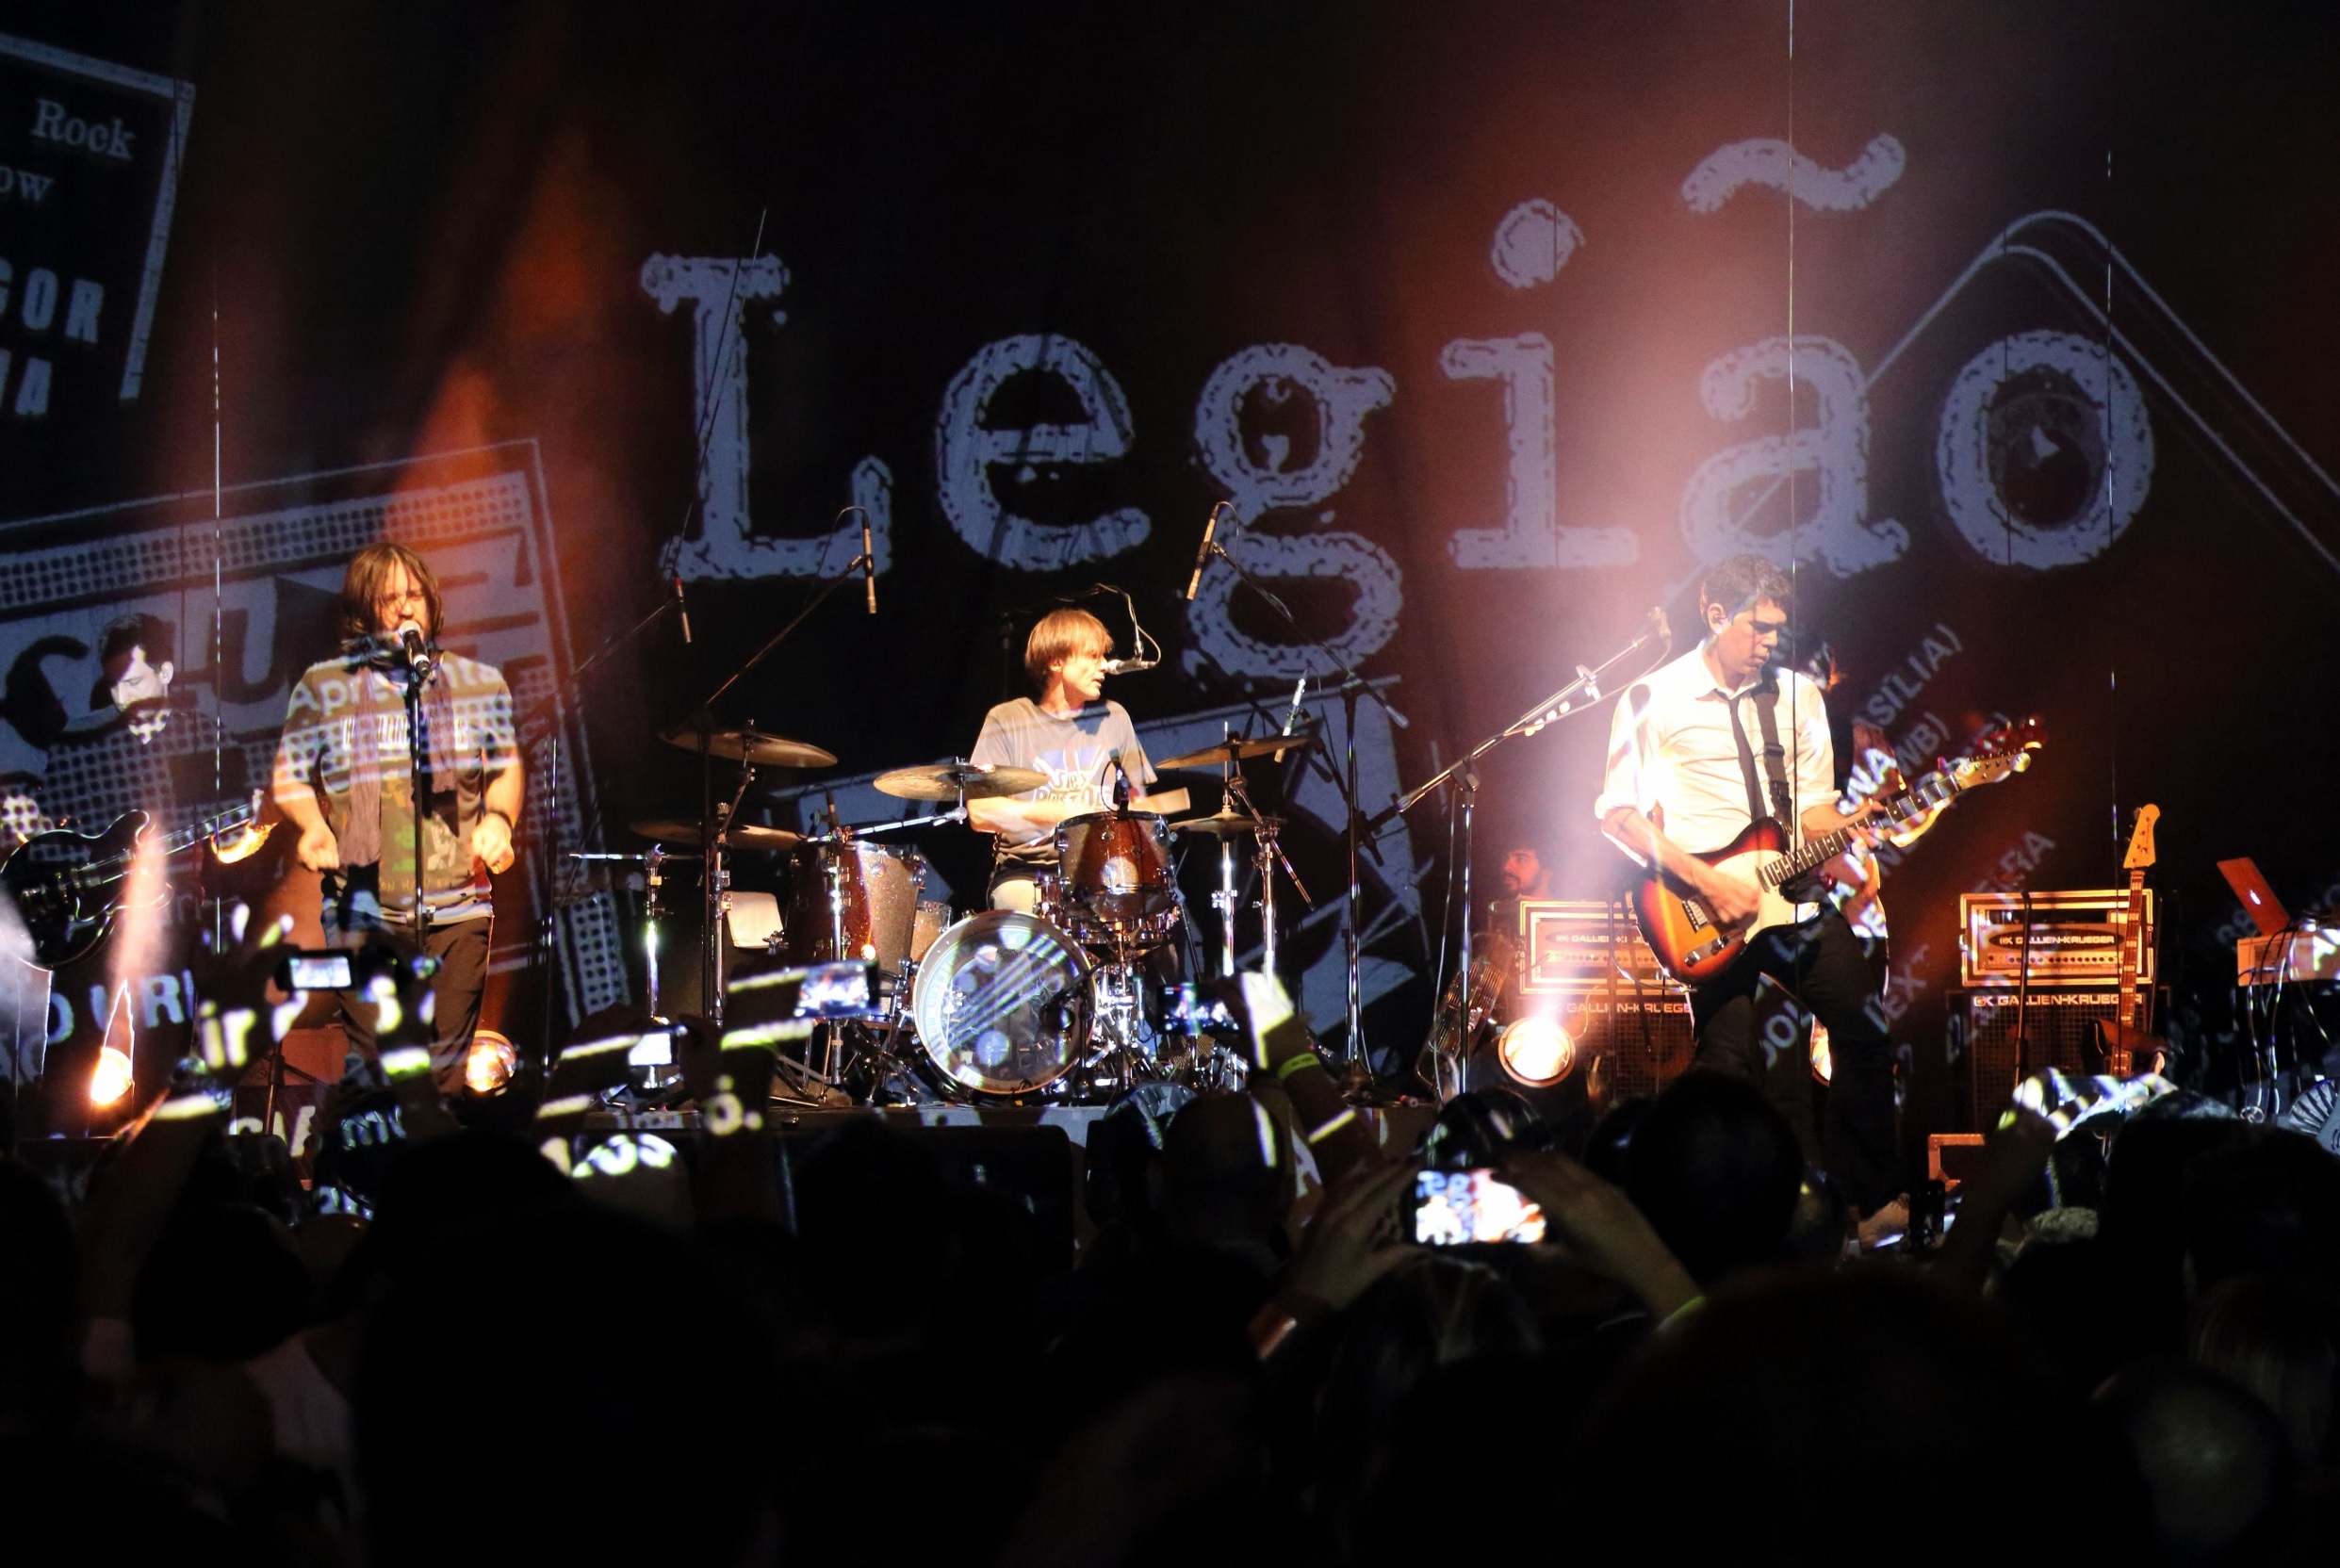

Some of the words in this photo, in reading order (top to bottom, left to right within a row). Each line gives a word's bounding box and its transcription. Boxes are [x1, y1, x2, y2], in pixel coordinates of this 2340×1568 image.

[31, 97, 136, 161] Rock
[639, 132, 2156, 680] Legião
[1997, 993, 2144, 1006] GALIEN-KRUEGR
